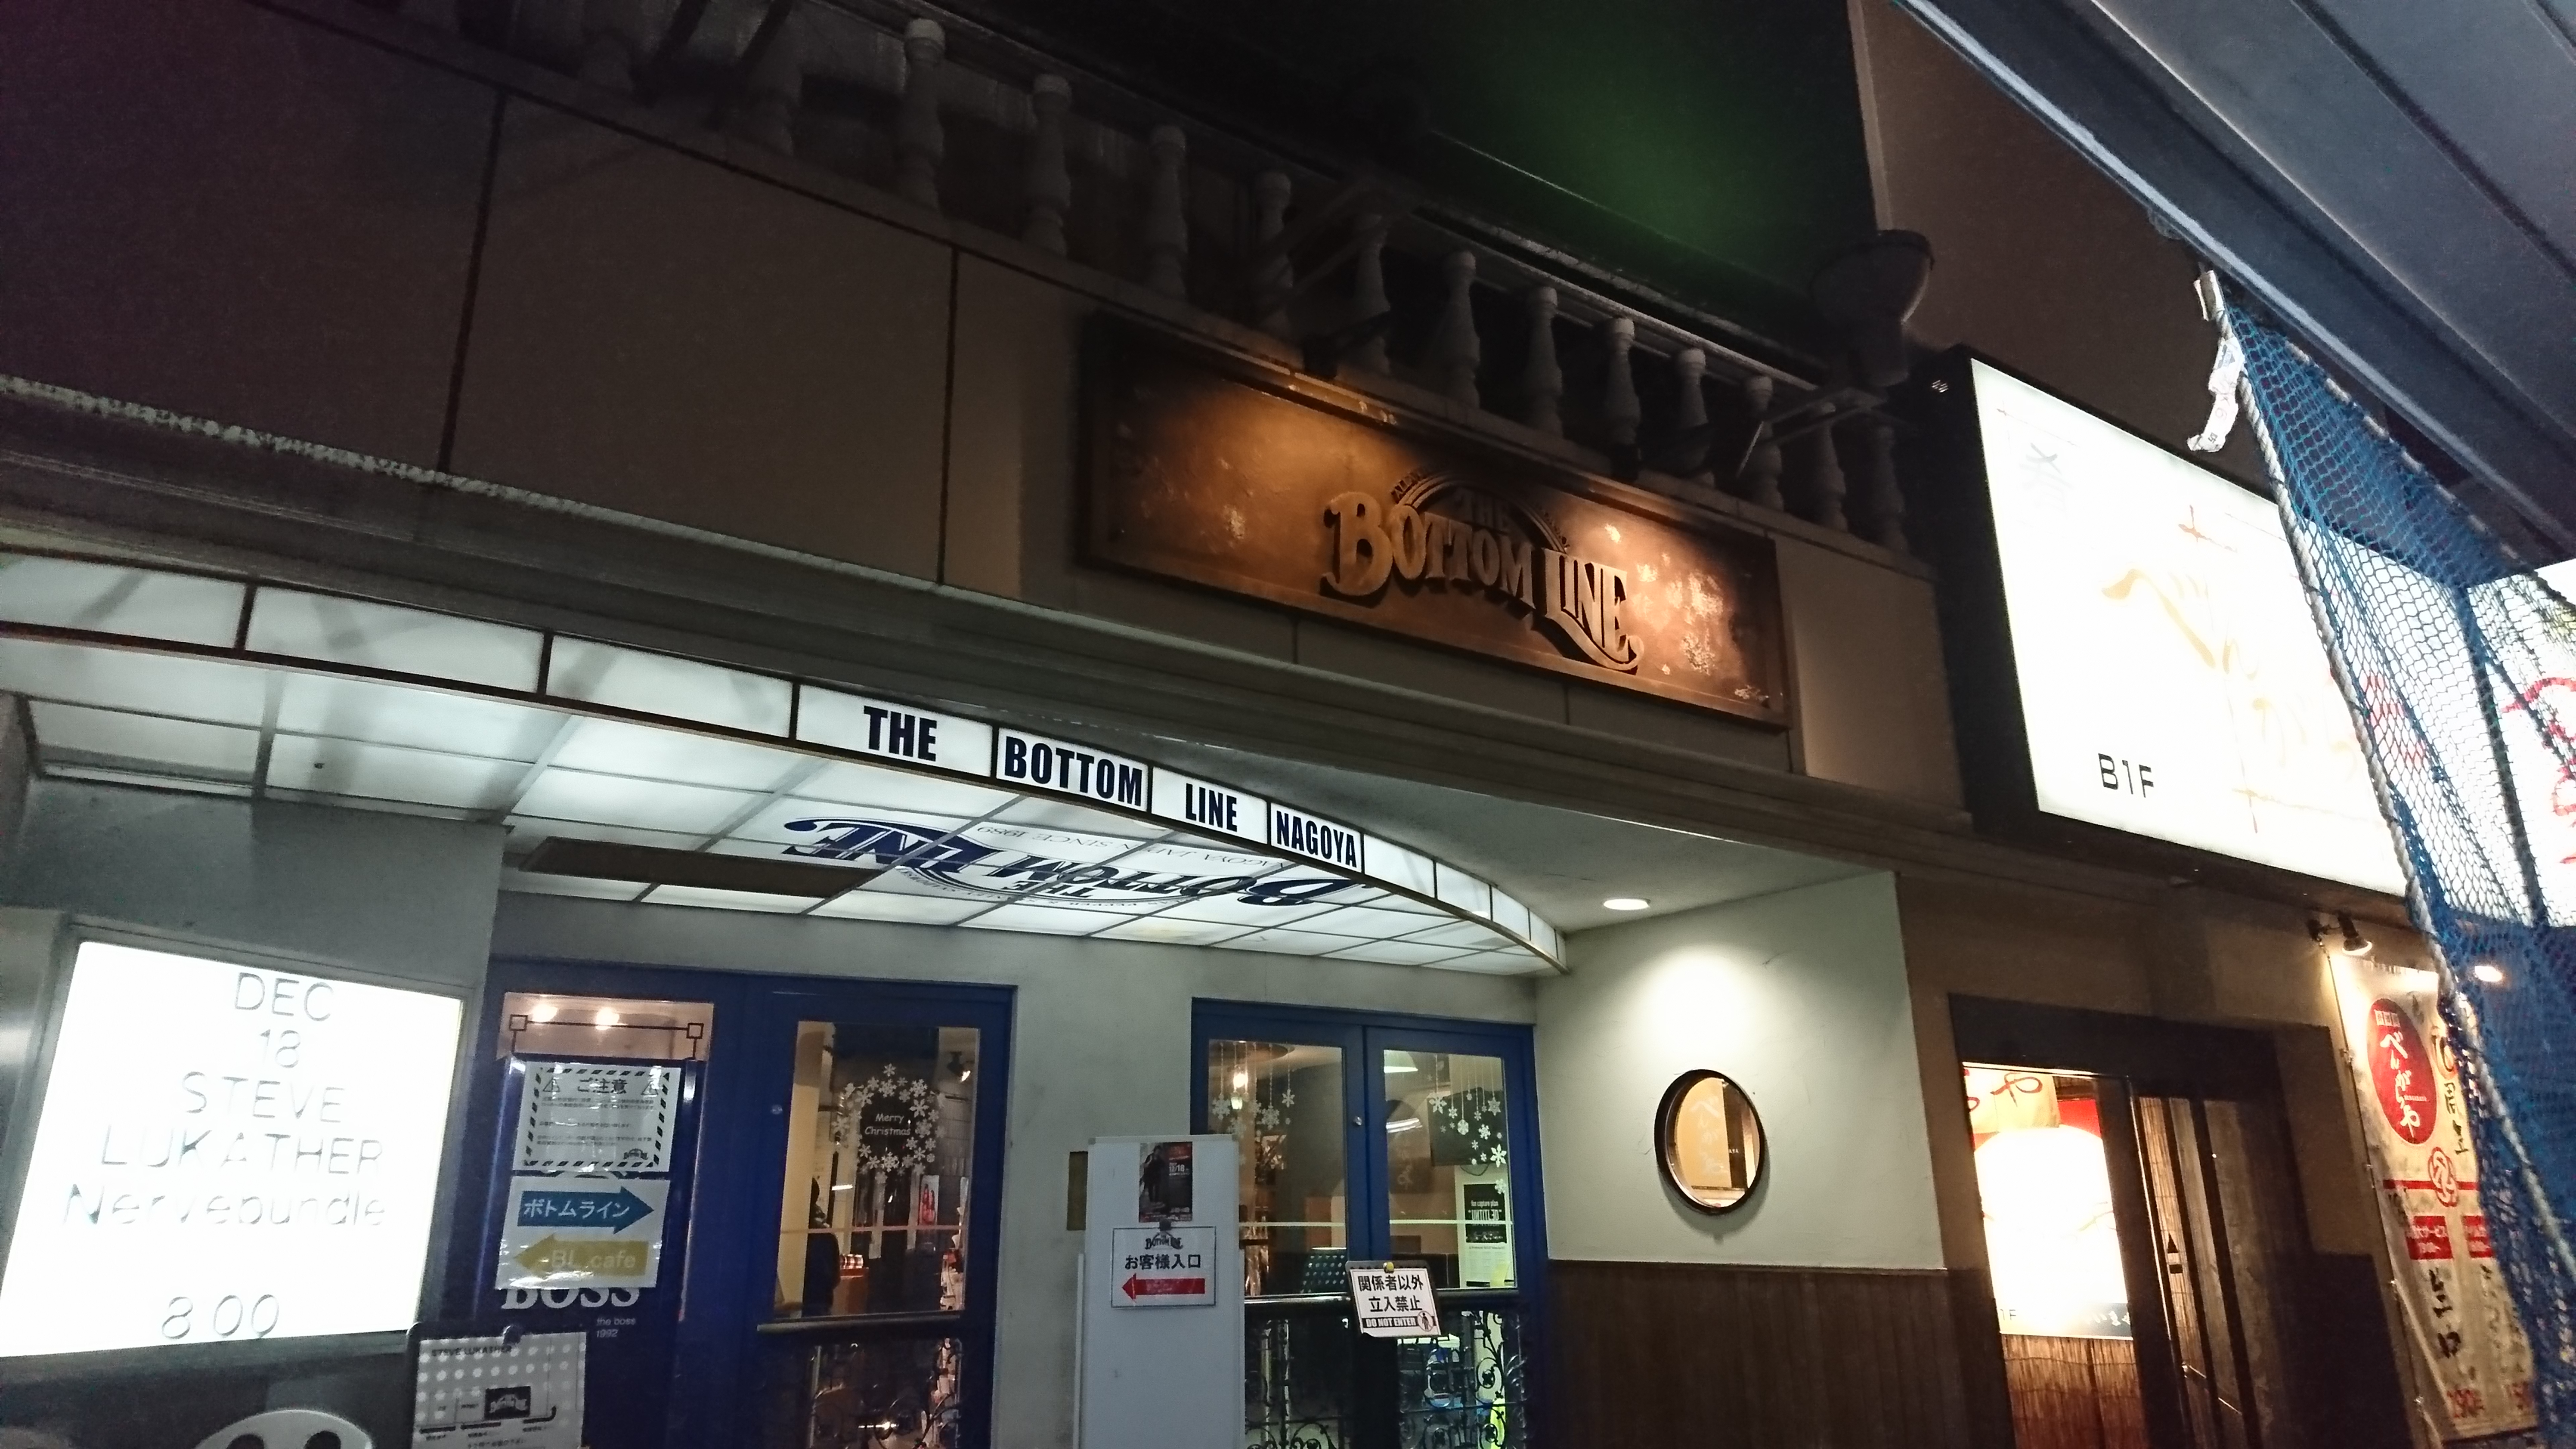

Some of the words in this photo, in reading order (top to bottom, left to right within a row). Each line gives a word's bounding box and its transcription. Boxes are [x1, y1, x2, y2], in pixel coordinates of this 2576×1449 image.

[1320, 491, 1536, 610] BOTTOM
[1544, 548, 1644, 671] LINE
[2098, 752, 2155, 798] B1F
[864, 705, 937, 762] THE
[1004, 736, 1142, 807] BOTTOM
[1186, 783, 1237, 832] LINE
[1276, 810, 1357, 868] NAGOYA
[977, 827, 1029, 838] 1989
[1031, 834, 1113, 847] SINCE
[1000, 881, 1093, 898] THE
[234, 971, 335, 1022] DEC
[259, 1028, 302, 1069] 18
[577, 1077, 628, 1094] ご注意
[182, 1071, 346, 1124] STEVE
[875, 1113, 905, 1124] Merry
[864, 1126, 911, 1136] Christmas
[101, 1124, 384, 1175] LUKATHER
[524, 1198, 630, 1219] ボトムライン
[1124, 1253, 1201, 1270] お客様入口
[1357, 1274, 1424, 1291] 関係者以外
[1368, 1295, 1423, 1312] 立入禁止
[1365, 1318, 1377, 1327] DO
[1378, 1318, 1393, 1327] NOT
[1394, 1317, 1416, 1326] ENTER
